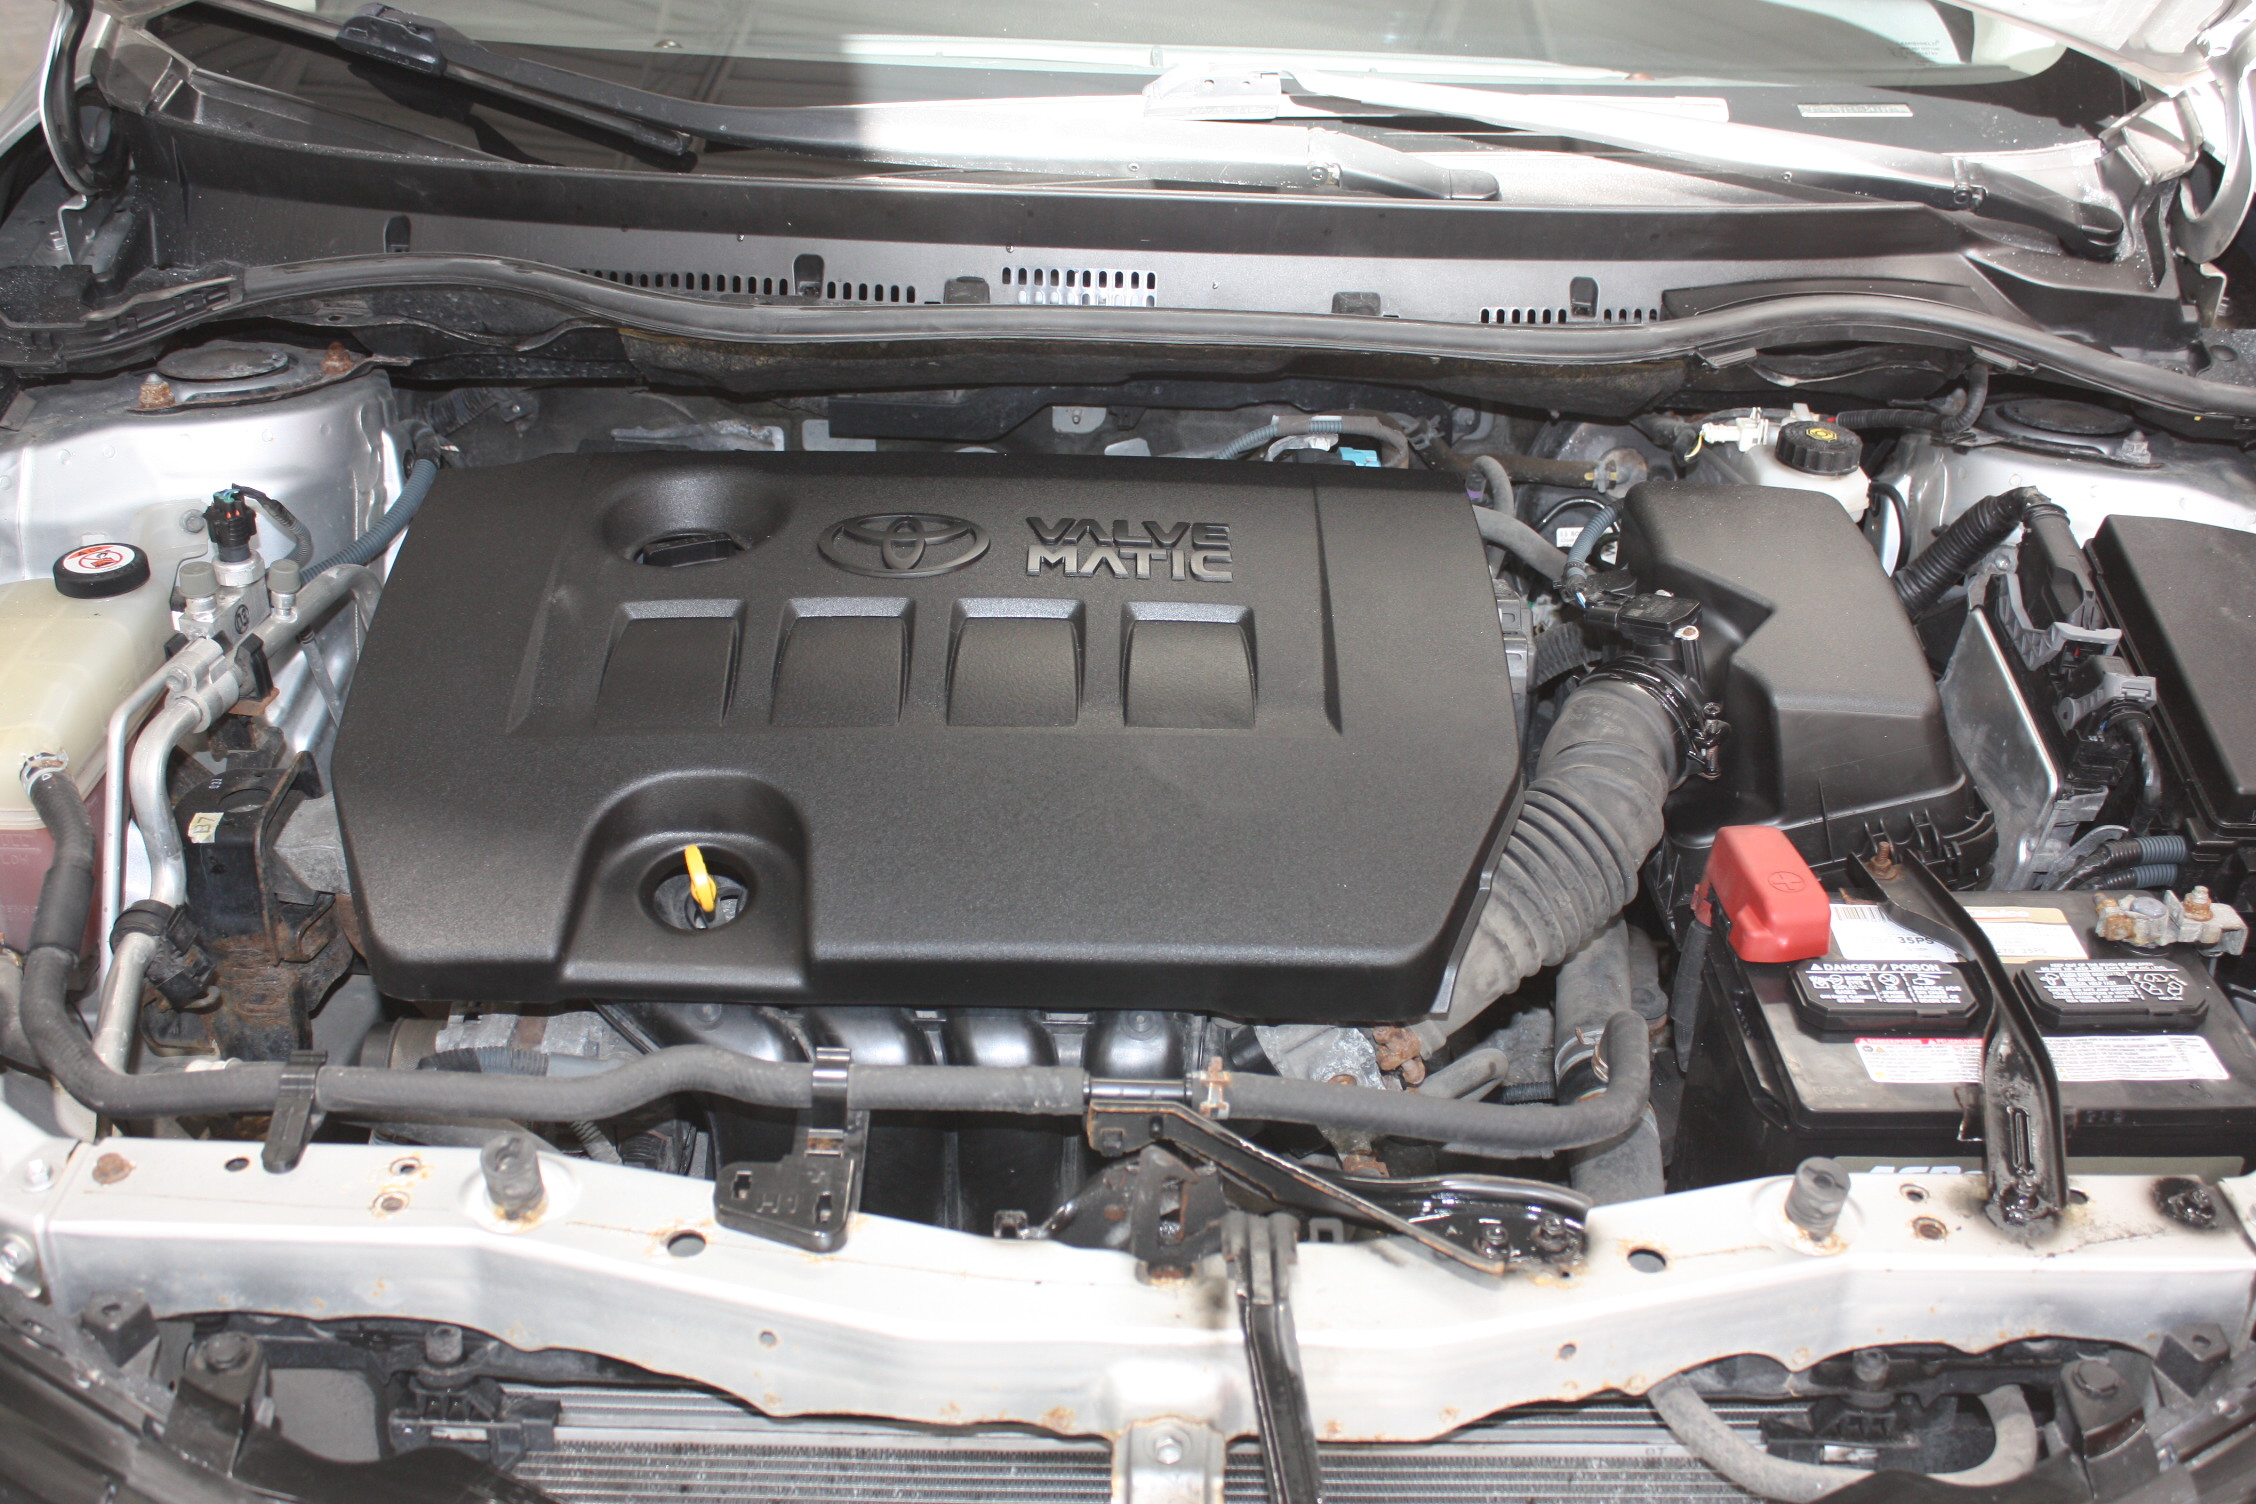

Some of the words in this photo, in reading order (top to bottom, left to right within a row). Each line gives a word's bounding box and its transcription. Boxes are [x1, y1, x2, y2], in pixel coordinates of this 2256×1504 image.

[1026, 516, 1233, 550] VALVE
[1026, 545, 1233, 582] MATIC
[1896, 936, 1934, 945] 35PS
[1822, 963, 1878, 971] DANGER
[1880, 963, 1887, 971] /
[1890, 963, 1941, 972] POISON
